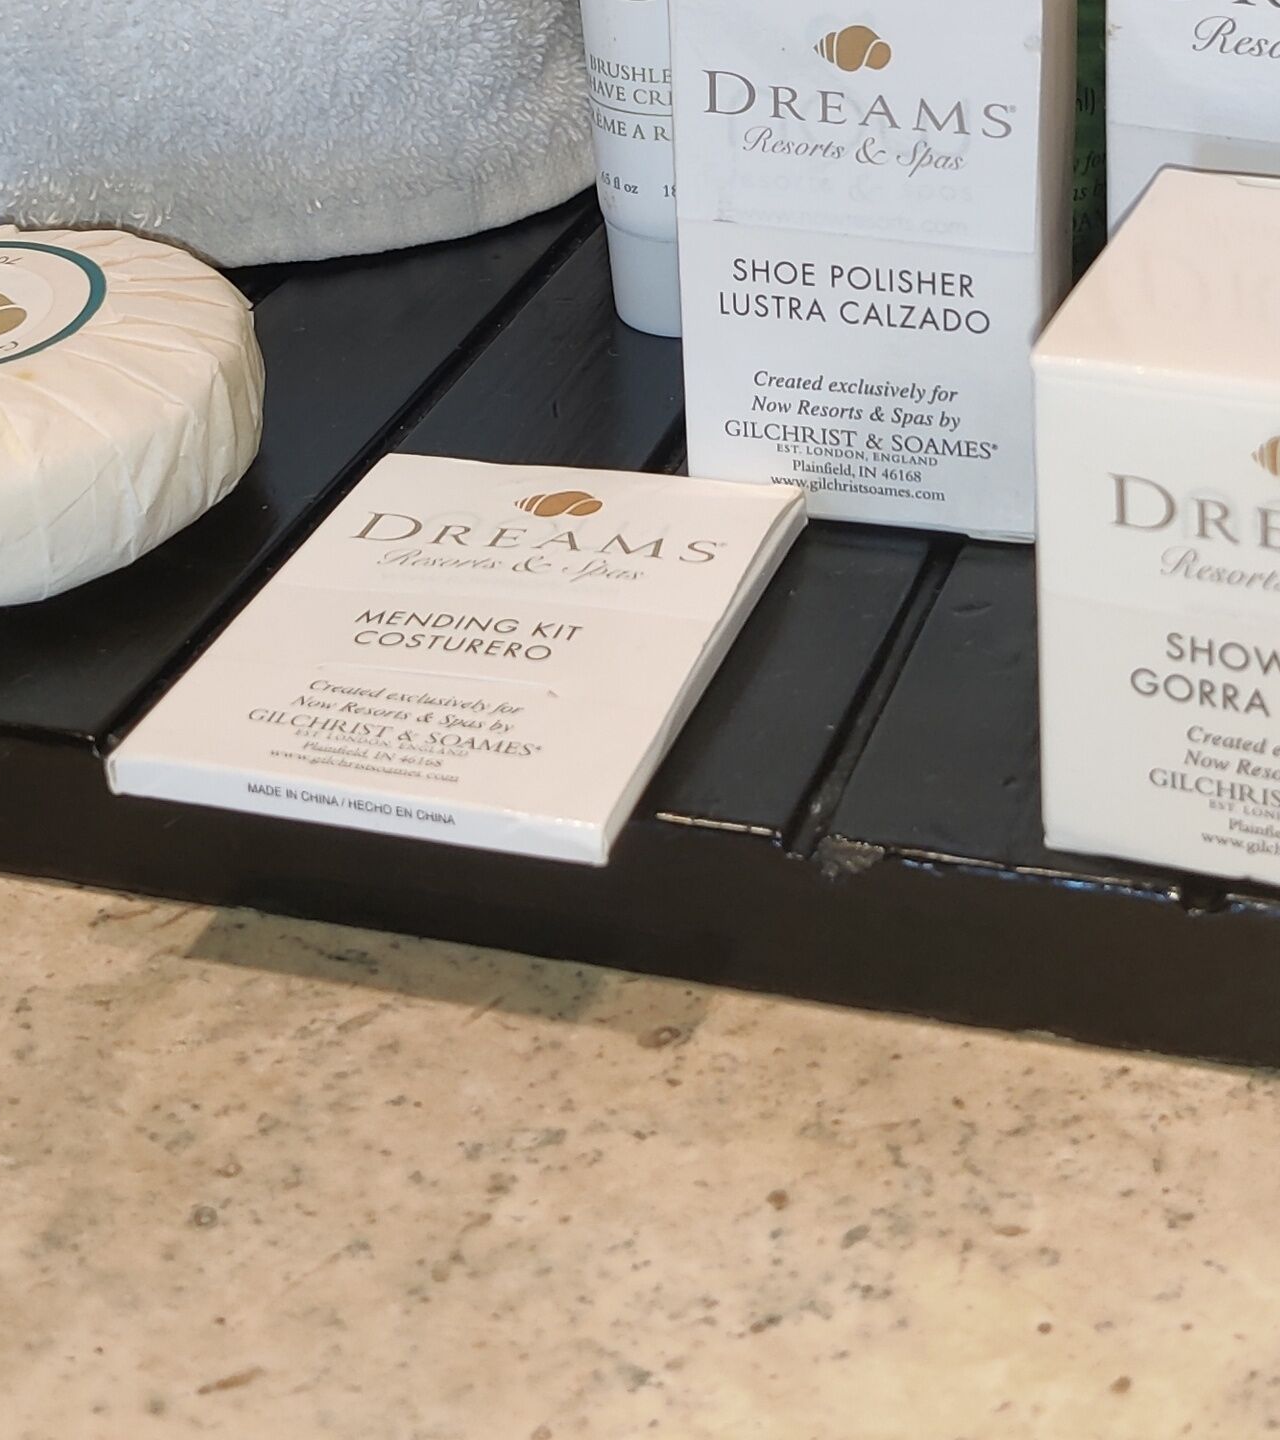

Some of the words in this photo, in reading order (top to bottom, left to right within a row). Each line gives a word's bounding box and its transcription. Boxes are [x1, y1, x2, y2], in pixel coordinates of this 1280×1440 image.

[589, 53, 672, 84] BRUSHLE
[742, 125, 846, 160] Resorts
[855, 136, 887, 165] &
[896, 140, 966, 178] Spas
[732, 258, 816, 287] SHOE
[830, 264, 975, 299] POLISHER
[719, 291, 827, 323] LUSTRA
[839, 301, 991, 335] CALZADO
[753, 370, 823, 392] Created
[828, 380, 926, 404] exclusively
[927, 385, 959, 405] for
[751, 395, 792, 414] Now
[797, 400, 863, 421] Resorts
[869, 406, 885, 422] &
[890, 408, 934, 429] Spas
[938, 411, 962, 432] by
[724, 420, 858, 448] GILCHRIST
[865, 433, 884, 450] &
[792, 458, 855, 478] Plainfield,
[858, 465, 877, 479] IN
[881, 468, 923, 484] 46168
[873, 452, 939, 467] ENGLAND
[771, 475, 946, 502] www.gilchristsoames.com
[377, 548, 503, 571] Resorts
[562, 558, 645, 583] Spas
[354, 609, 520, 635] MENDING
[531, 620, 584, 642] KIT
[353, 630, 553, 662] COSTURERO
[1130, 667, 1271, 719] GORRA
[248, 708, 395, 740] GILCHRIST
[1186, 724, 1267, 756] Created
[1184, 748, 1230, 771] Now
[247, 781, 282, 799] MADE
[285, 786, 299, 801] IN
[300, 790, 340, 808] CHINA
[348, 798, 393, 815] HECHO
[395, 804, 414, 819] EN
[416, 808, 457, 826] CHINA
